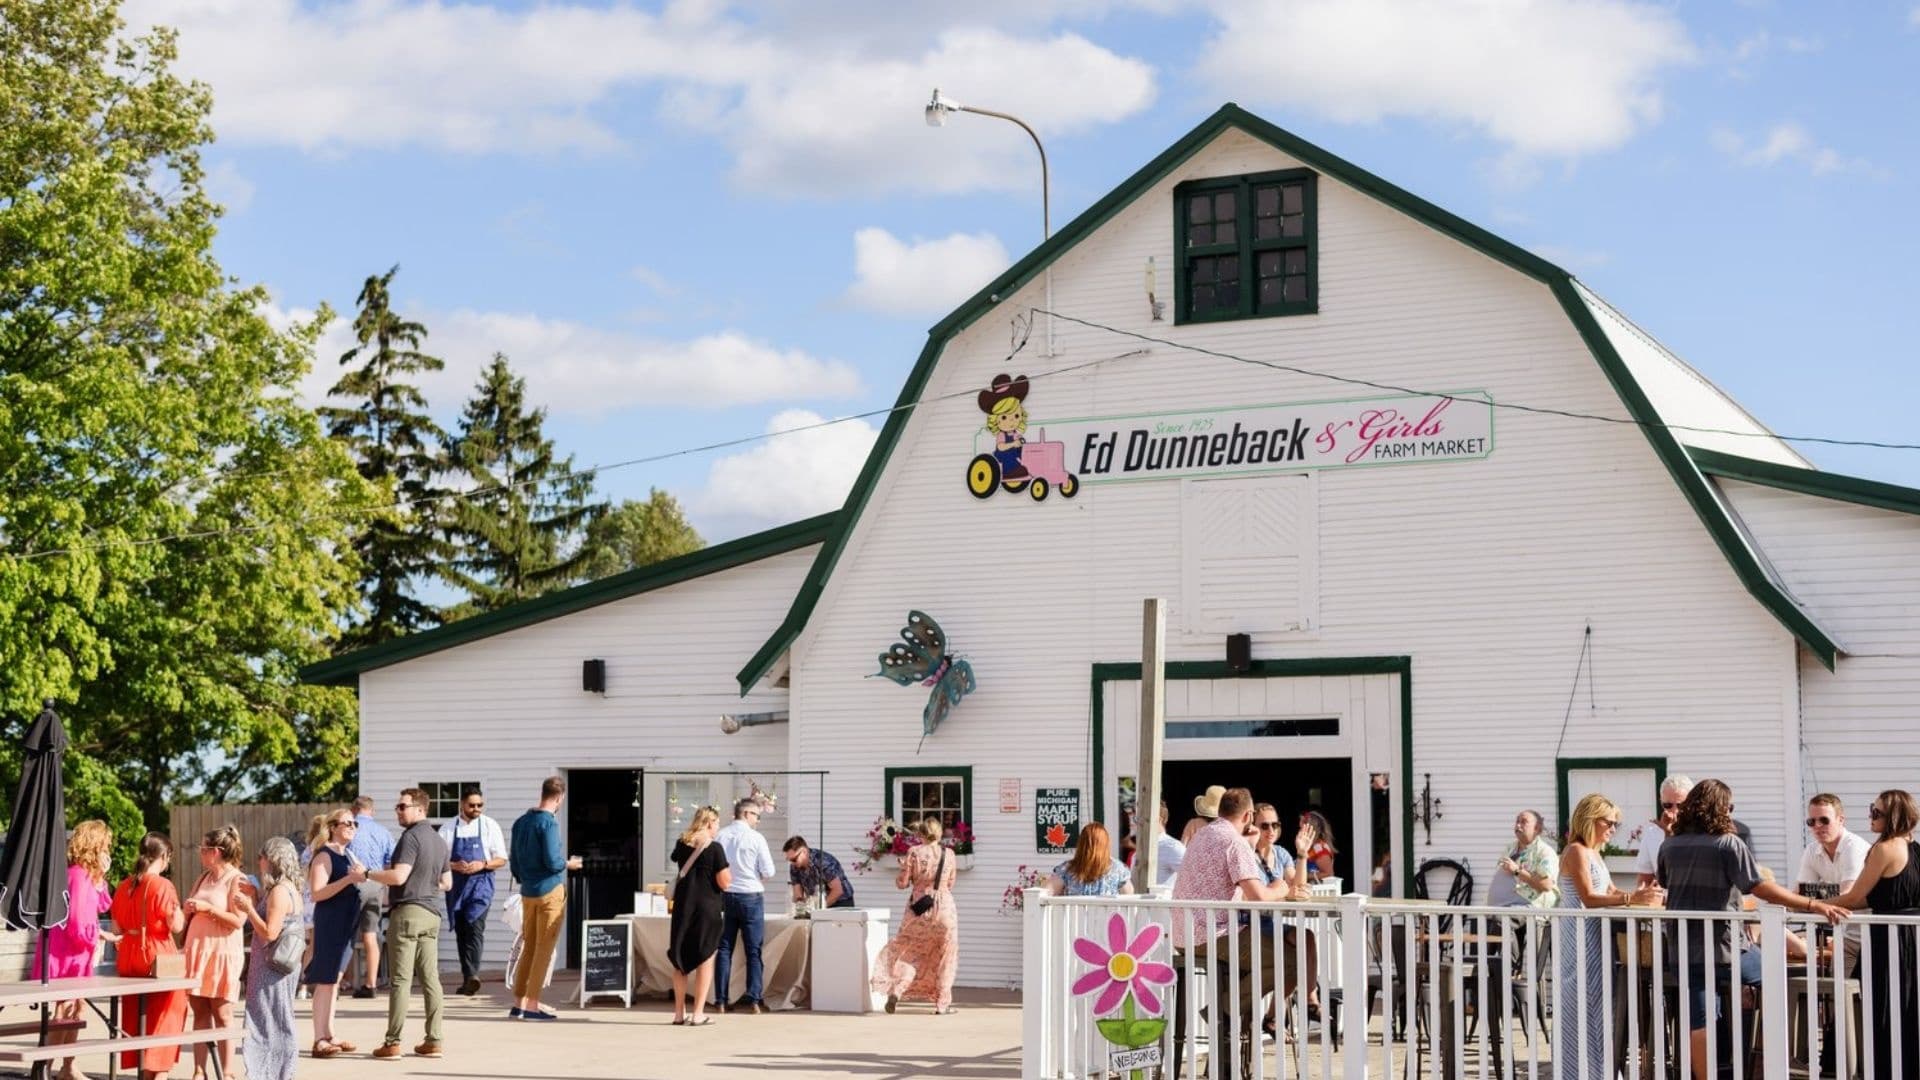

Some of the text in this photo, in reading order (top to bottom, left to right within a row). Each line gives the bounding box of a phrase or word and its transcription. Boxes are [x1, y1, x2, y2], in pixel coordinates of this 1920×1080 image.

[1079, 396, 1453, 475] Ed Dunneback & Girls
[1152, 421, 1185, 435] Since
[1374, 438, 1486, 459] FARM MARKET
[1037, 804, 1078, 815] MAPLE
[1037, 814, 1078, 825] SYRUP
[1114, 1049, 1158, 1068] WELCOME
